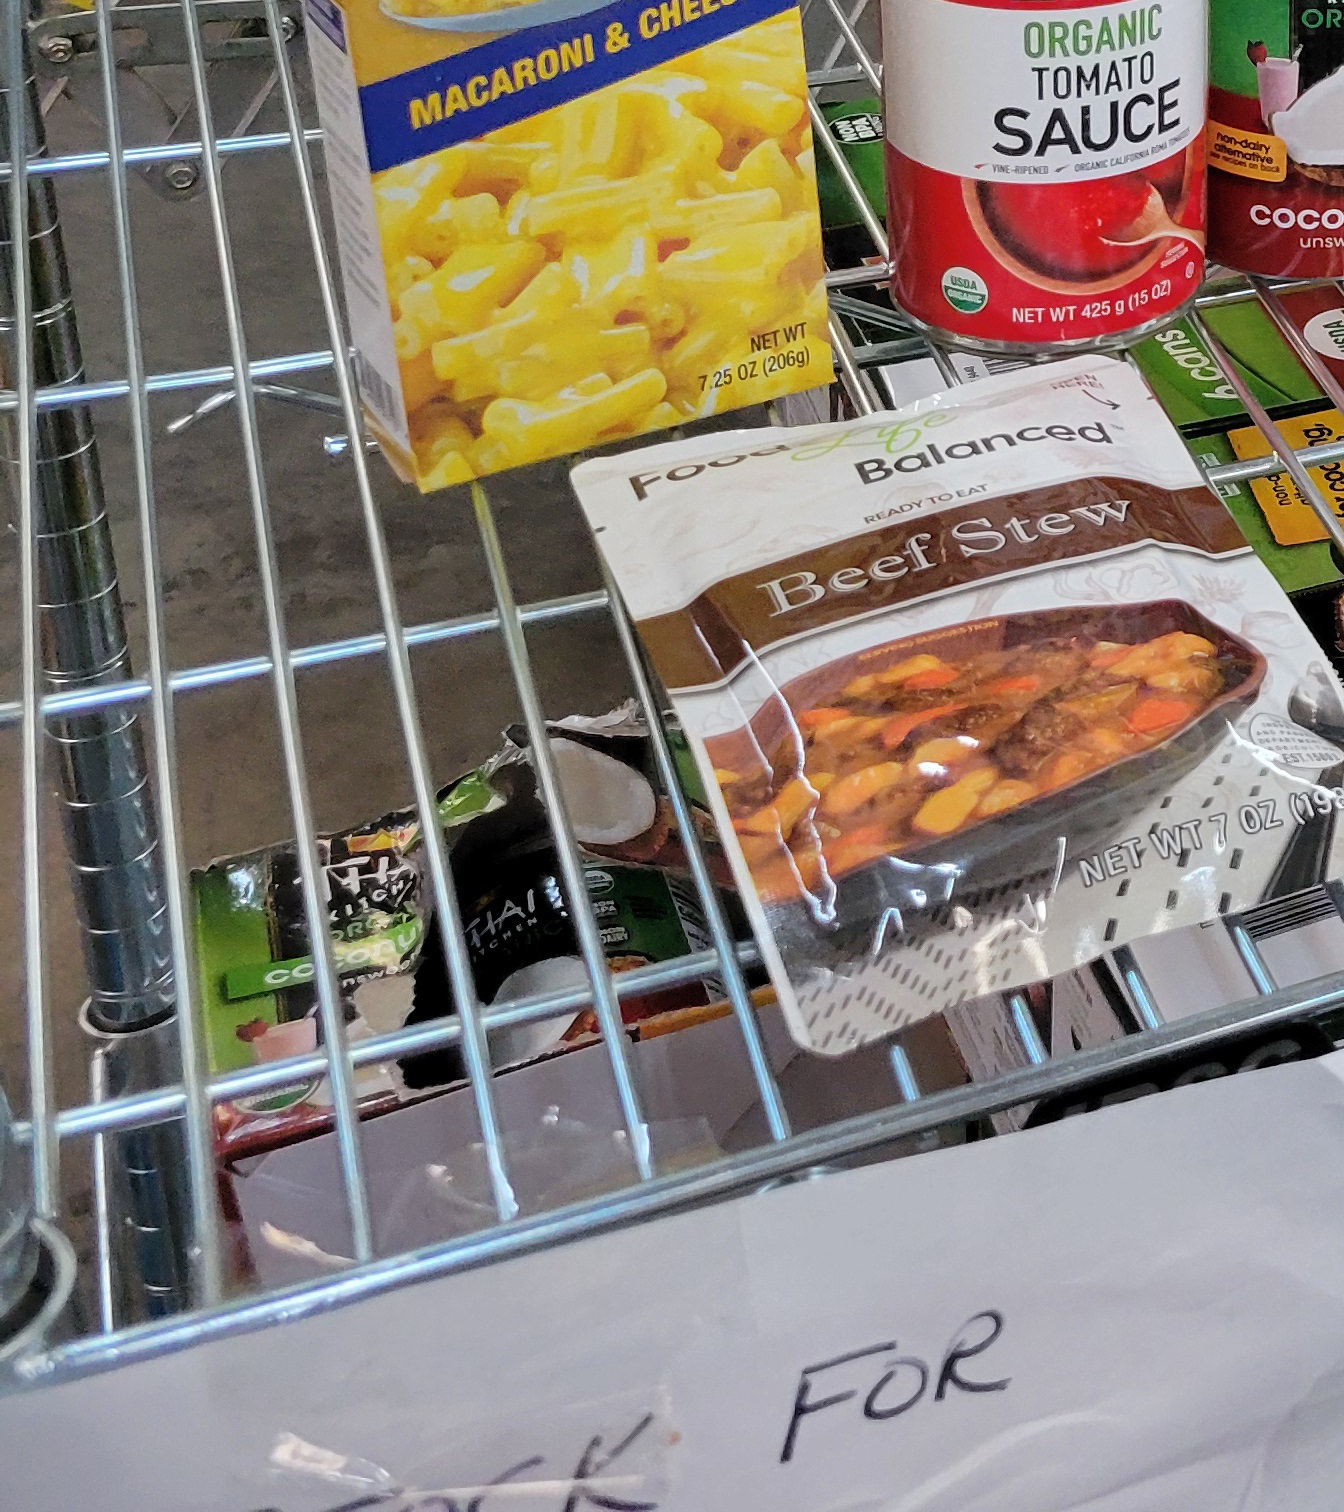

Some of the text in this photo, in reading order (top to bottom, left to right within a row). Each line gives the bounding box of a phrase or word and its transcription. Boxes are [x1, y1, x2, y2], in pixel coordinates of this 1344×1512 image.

[1024, 4, 1163, 58] ORGANIC
[409, 35, 596, 130] MACARONI
[604, 22, 630, 54] &
[1032, 50, 1154, 101] TOMATO
[992, 77, 1182, 157] SAUCE
[1011, 280, 1171, 324] NET WT 425 g (15 OZ)
[699, 346, 810, 392] 7.25 OZ (206g)
[854, 420, 1112, 487] Balanced
[862, 482, 988, 525] READY TO EAT
[757, 498, 1131, 619] Beef Stew
[1077, 838, 1146, 888] NET
[1153, 818, 1208, 865] WT
[1213, 818, 1227, 850] 7
[1238, 799, 1284, 837] OZ
[780, 1310, 1011, 1465] FOR
